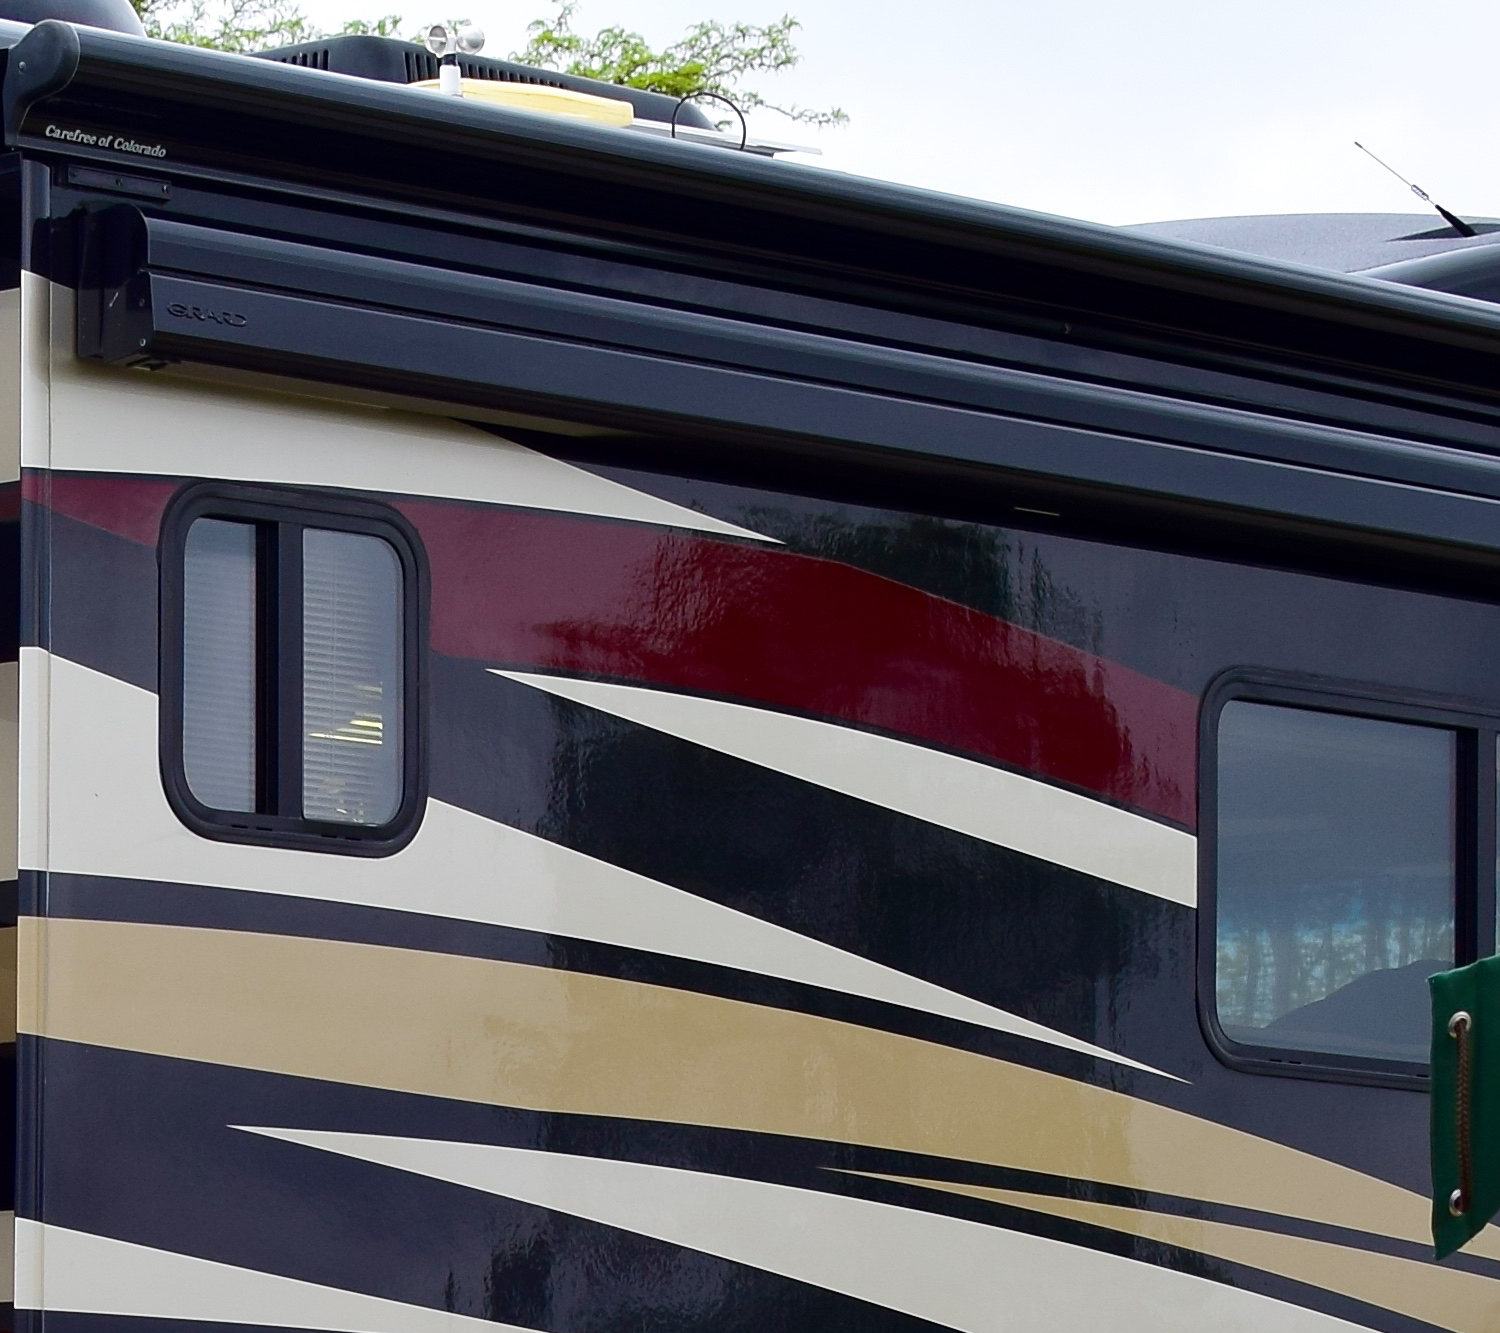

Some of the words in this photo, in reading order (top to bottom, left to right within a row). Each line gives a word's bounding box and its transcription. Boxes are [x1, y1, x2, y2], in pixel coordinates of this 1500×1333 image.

[45, 124, 97, 145] Carefree
[98, 135, 113, 148] of
[114, 137, 166, 158] Colorado
[166, 302, 247, 328] GIRARD
